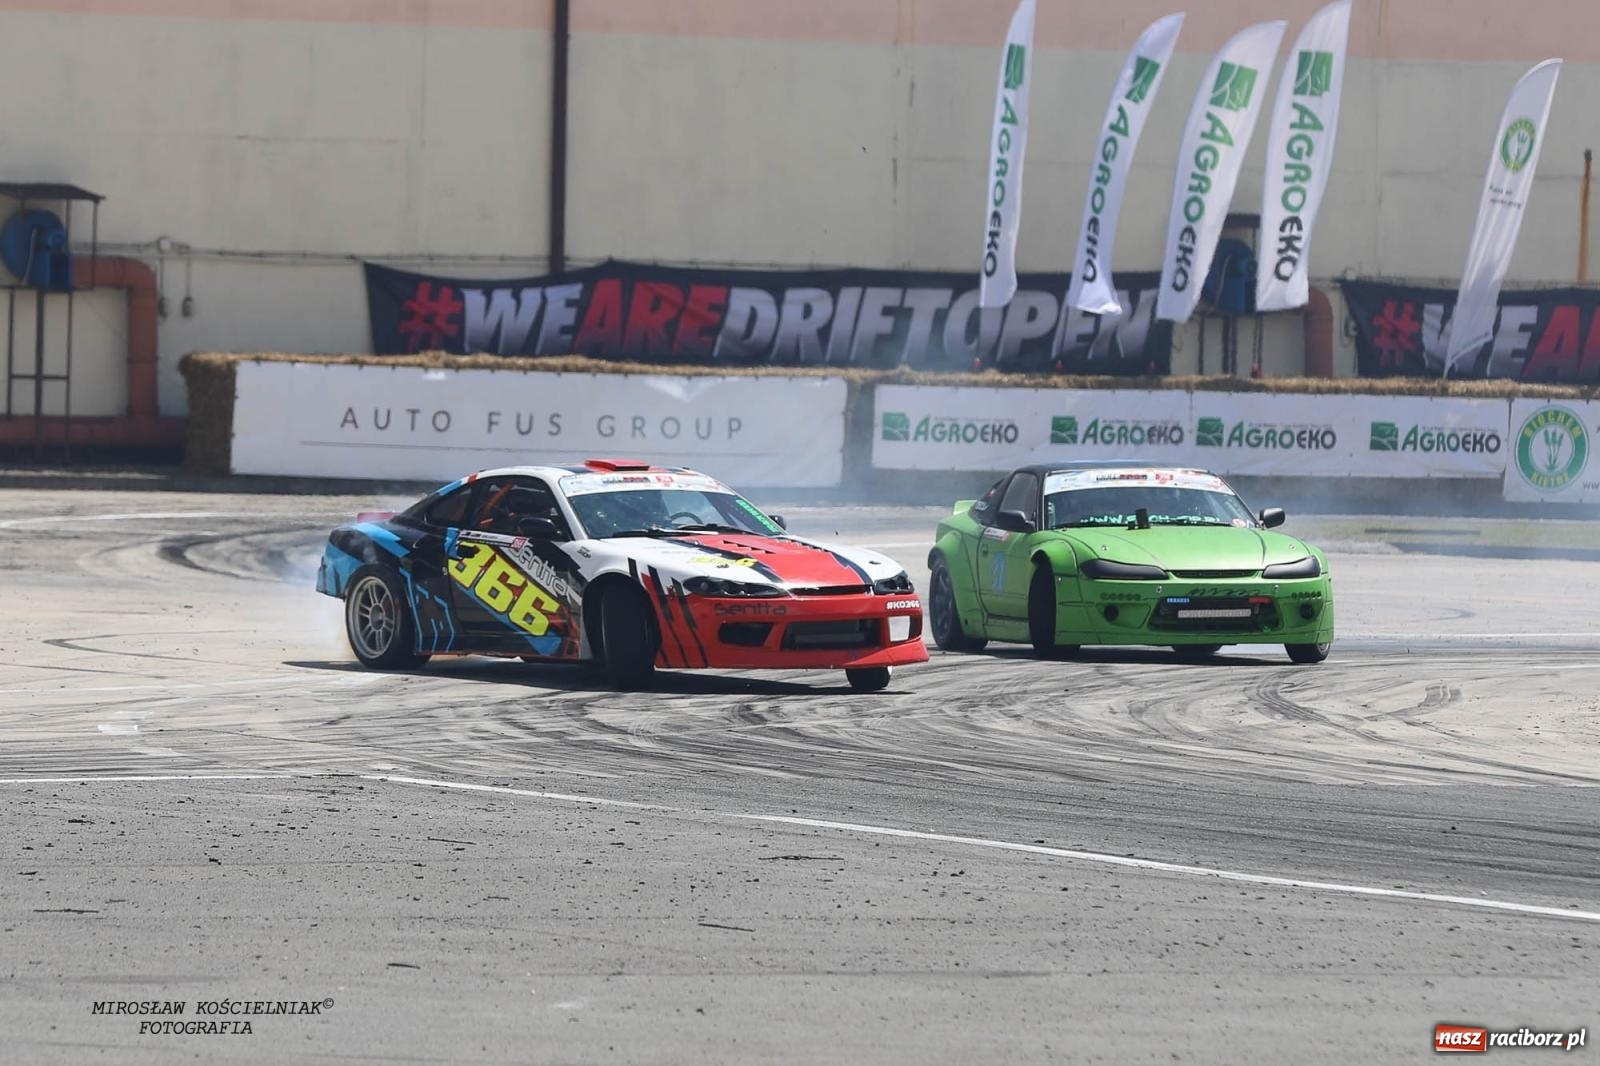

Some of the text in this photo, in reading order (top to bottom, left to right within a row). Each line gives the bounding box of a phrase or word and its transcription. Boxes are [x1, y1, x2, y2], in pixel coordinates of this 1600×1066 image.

[984, 97, 1019, 278] AGROEKO
[1172, 111, 1235, 292] AGROEKO
[1275, 102, 1325, 282] AGROEKO
[340, 407, 743, 440] AUTO FUS GROUP
[912, 416, 1020, 444] AGROEKO
[1081, 418, 1185, 446] AGROEKO
[1227, 420, 1337, 450] AGROEKO
[1401, 424, 1501, 454] AGROEKO
